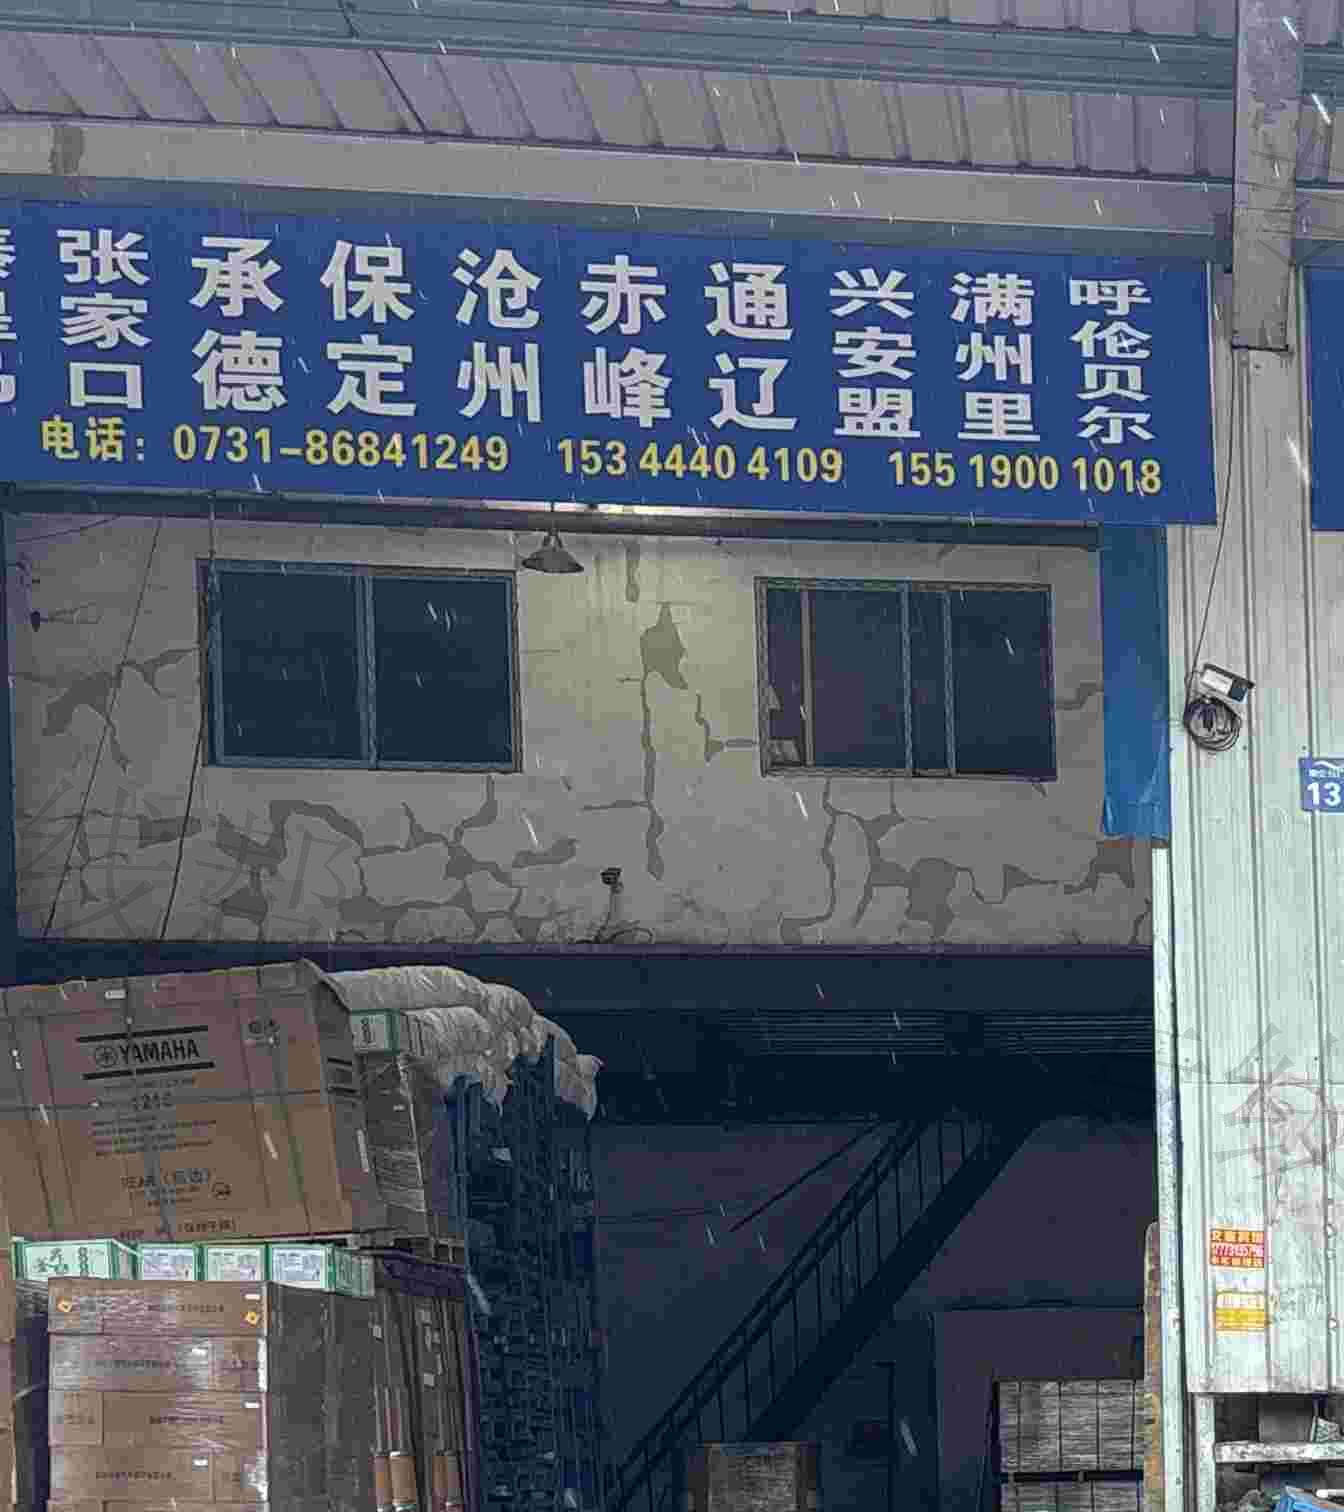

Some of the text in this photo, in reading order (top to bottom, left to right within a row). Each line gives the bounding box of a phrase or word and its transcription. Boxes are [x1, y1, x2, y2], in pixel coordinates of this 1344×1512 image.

[57, 229, 151, 408] 张家口
[190, 237, 286, 411] 承德
[320, 238, 416, 416] 保定
[453, 249, 541, 422] 沧州
[581, 255, 671, 427] 赤峰
[704, 262, 796, 429] 通辽
[830, 269, 920, 437] 兴安盟
[950, 273, 1040, 441] 满州里
[1070, 280, 1153, 443] 呼伦贝尔
[559, 440, 626, 474] 153
[640, 442, 735, 479] 4440
[748, 447, 842, 482] 4109
[889, 452, 954, 486] 155
[970, 455, 1058, 489] 1900
[1072, 458, 1161, 495] 1018
[119, 1039, 200, 1065] YAMAHA
